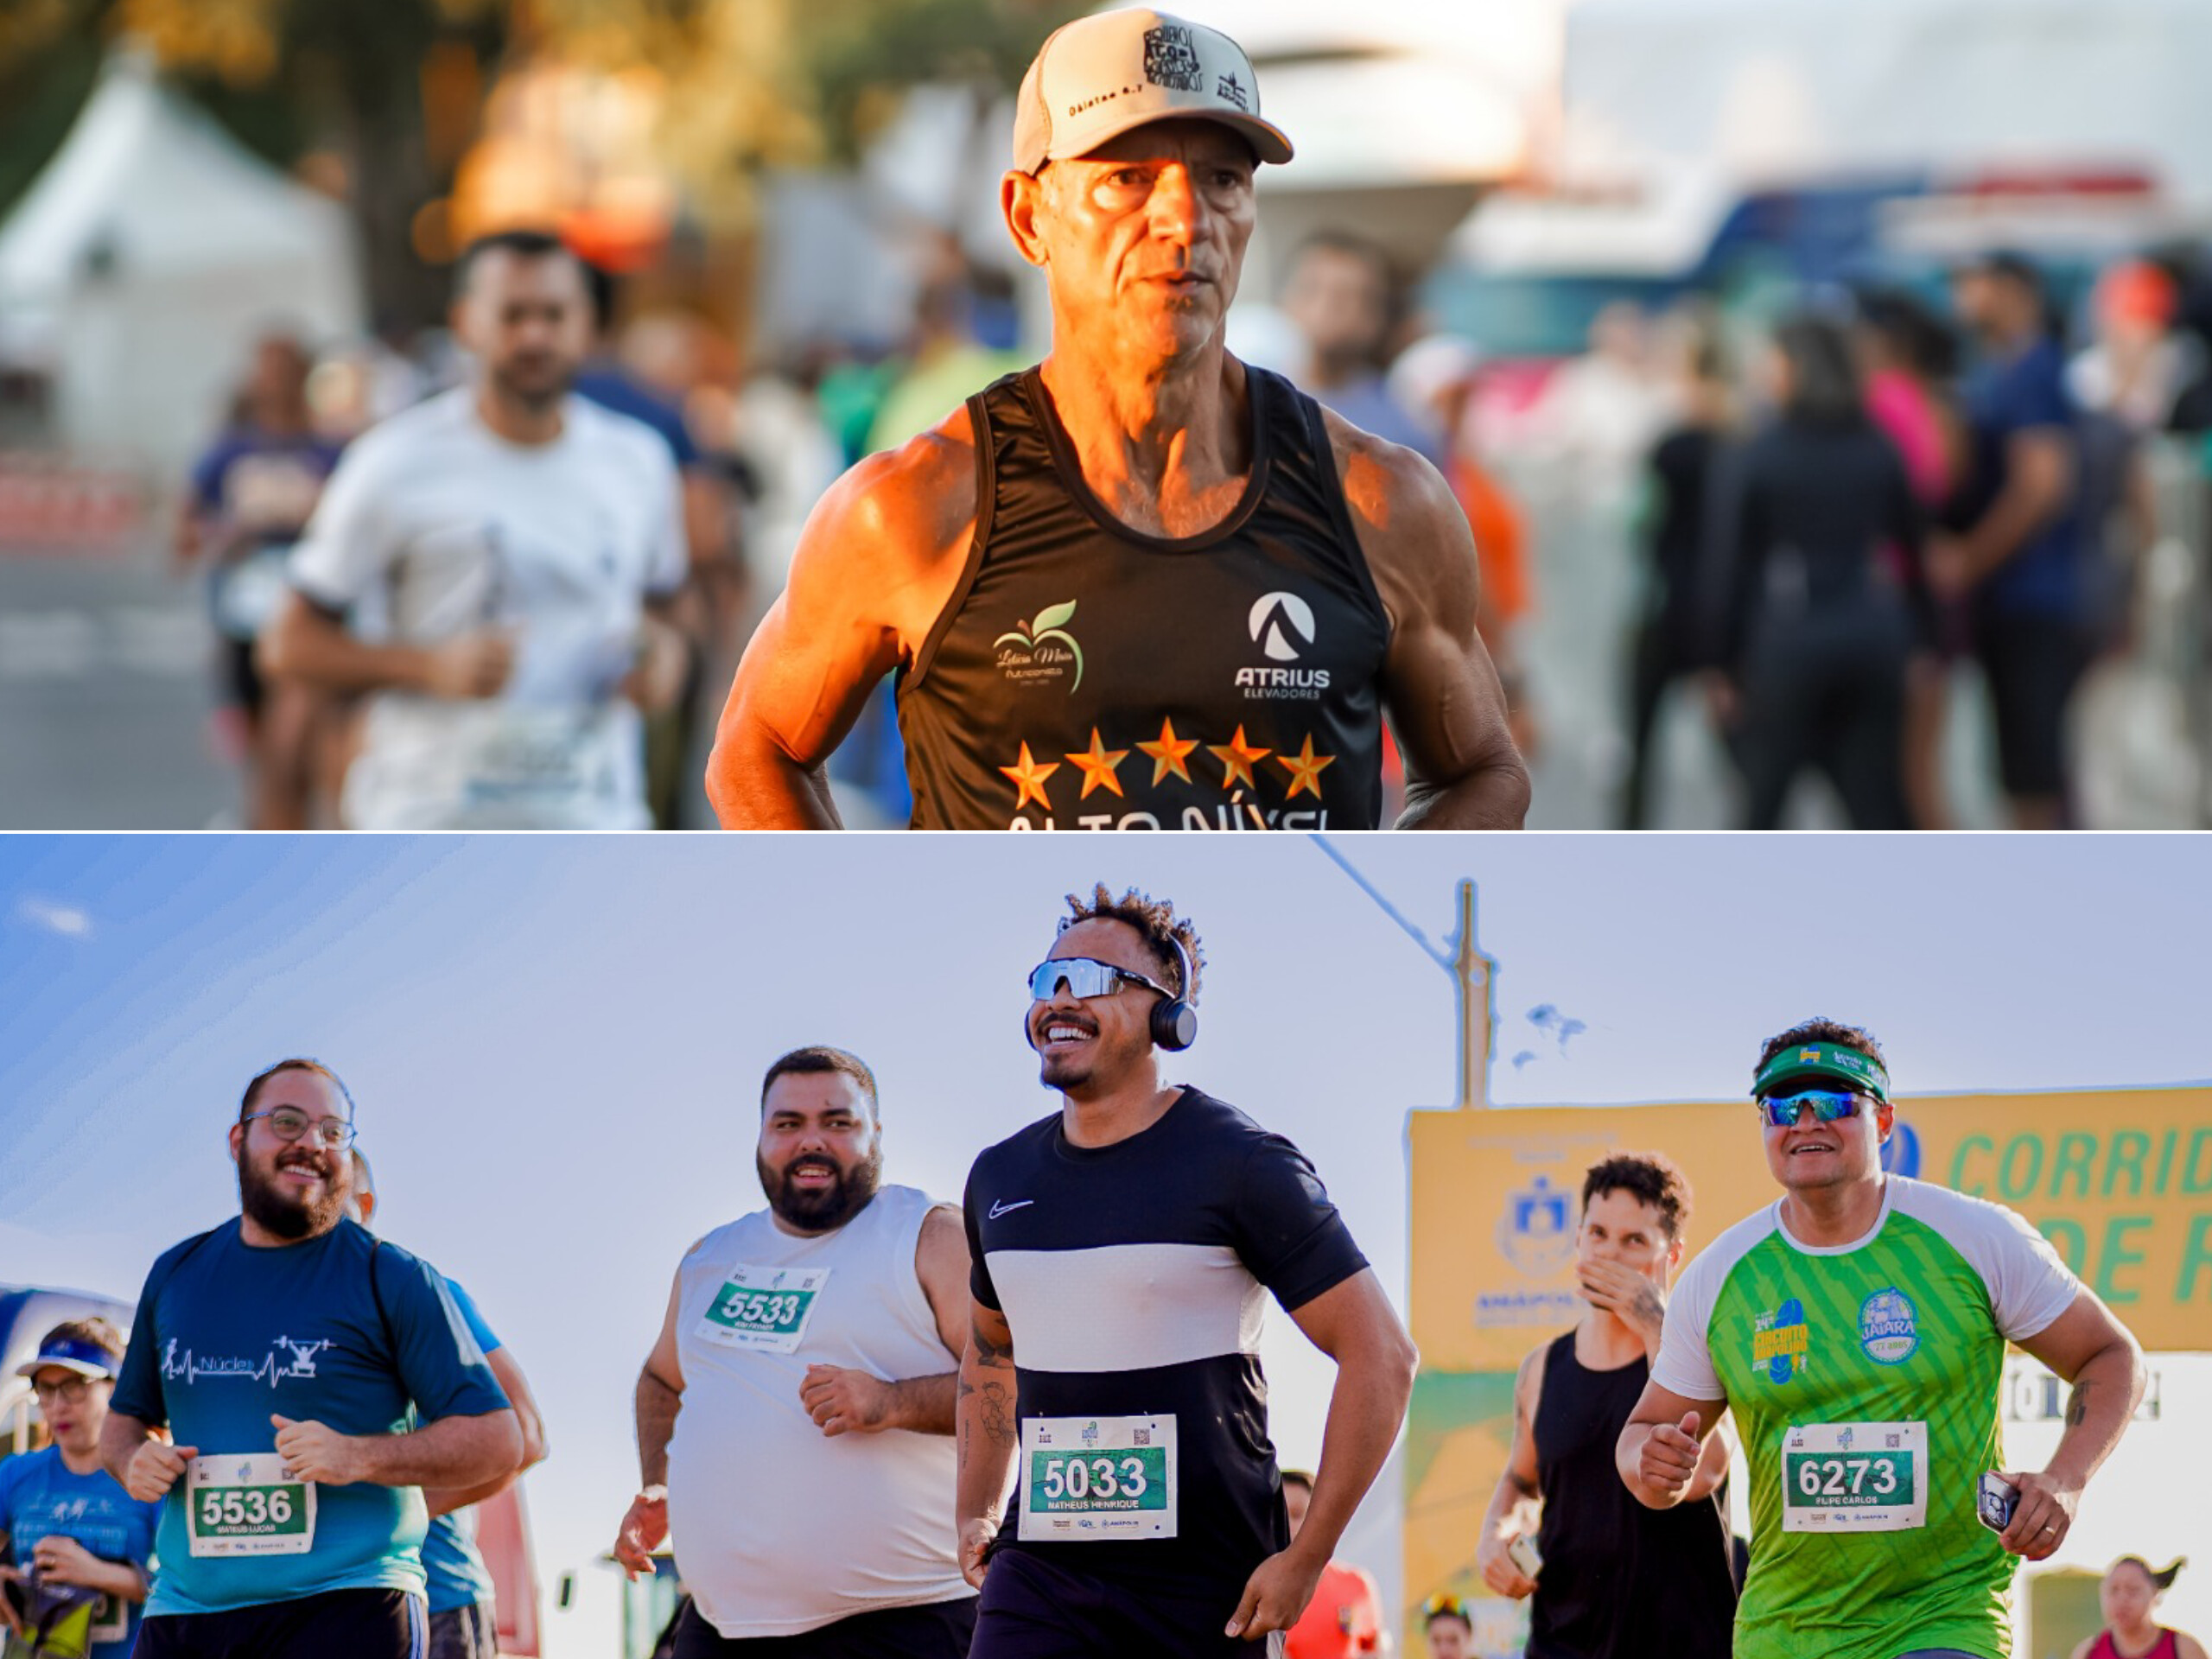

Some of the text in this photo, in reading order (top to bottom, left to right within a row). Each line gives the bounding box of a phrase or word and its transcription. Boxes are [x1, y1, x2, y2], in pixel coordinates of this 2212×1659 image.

[1234, 667, 1331, 689] ATRIUS
[1243, 687, 1320, 700] ELEVADORES
[721, 1292, 799, 1325] 5533
[1043, 1458, 1147, 1498] 5033
[1800, 1459, 1897, 1496] 6273
[202, 1490, 292, 1525] 5536
[1047, 1500, 1139, 1510] MATHEUS HENRIQUE
[1842, 1496, 1877, 1504] CARLOS
